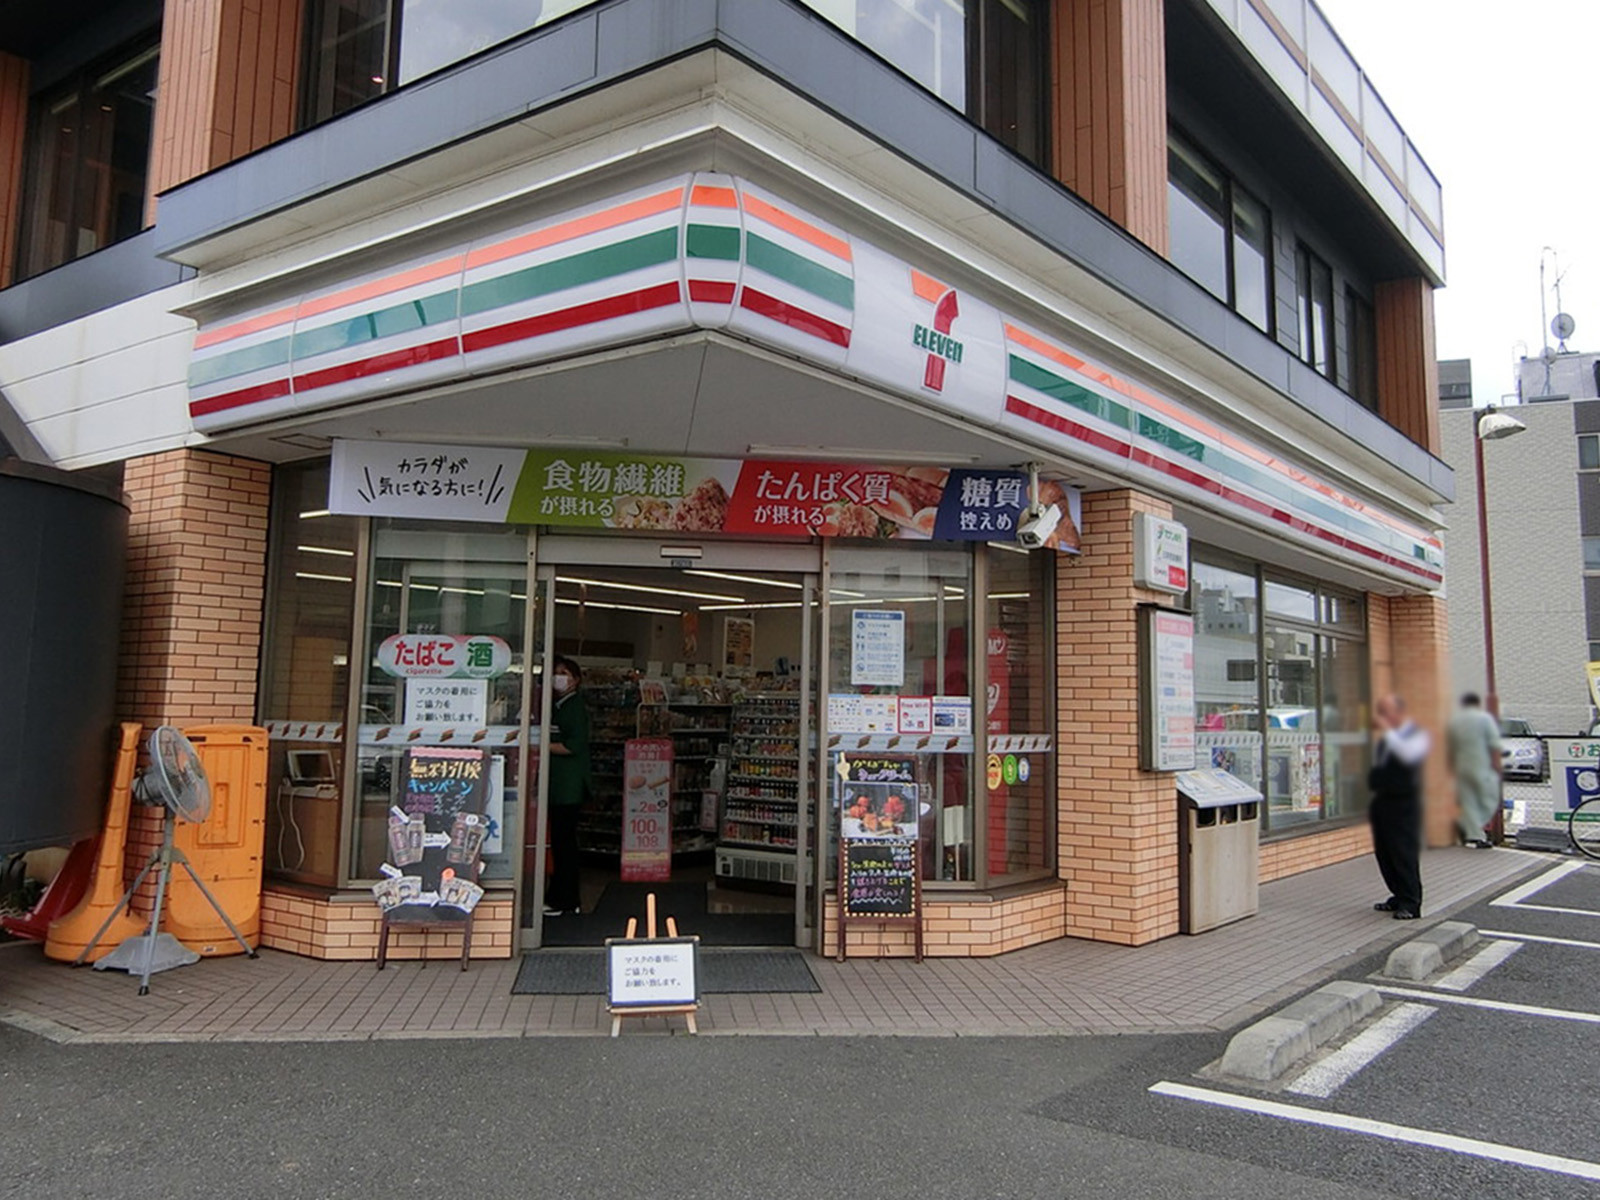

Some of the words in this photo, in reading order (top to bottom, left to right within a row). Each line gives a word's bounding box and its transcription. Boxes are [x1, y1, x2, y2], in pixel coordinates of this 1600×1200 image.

[397, 456, 469, 475] カラダが
[542, 459, 686, 497] 食物繊維
[755, 470, 892, 505] たんぱく質
[959, 476, 1022, 510] 糖質
[540, 498, 614, 518] が摂れる
[753, 505, 825, 526] が摂れる
[959, 511, 1013, 532] 控えめ
[395, 640, 455, 666] たばこ
[467, 642, 494, 667] 酒
[416, 687, 478, 696] マスクの着用に
[416, 700, 451, 709] ご協力を
[625, 967, 656, 976] ご協力を
